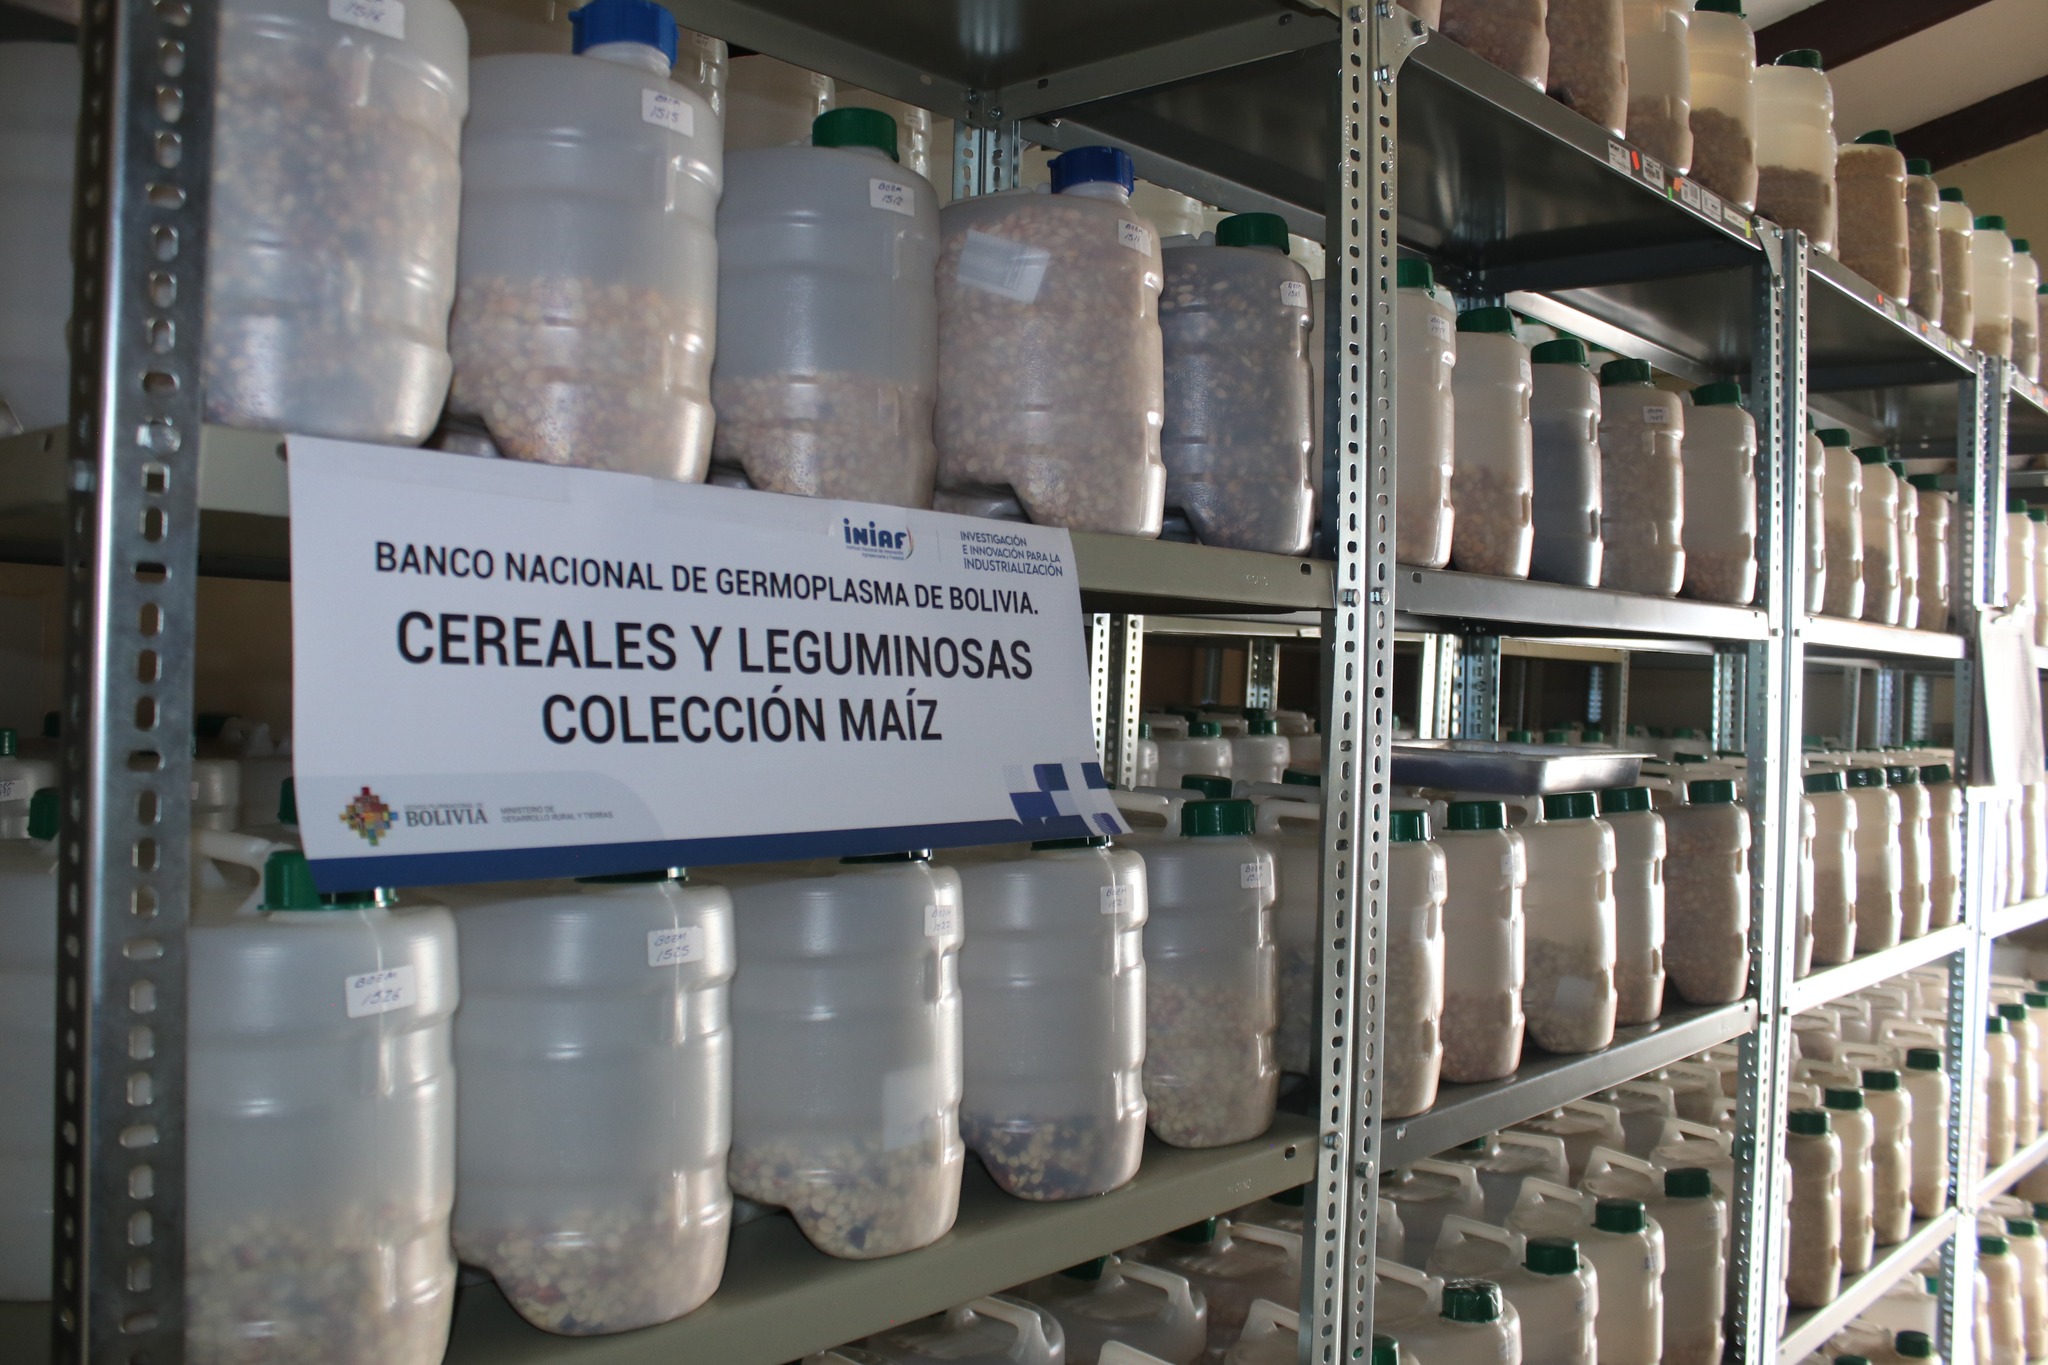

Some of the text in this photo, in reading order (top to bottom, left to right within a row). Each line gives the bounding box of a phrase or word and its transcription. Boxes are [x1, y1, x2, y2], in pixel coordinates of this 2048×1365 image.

[882, 194, 903, 206] 1512
[960, 531, 1027, 547] INVESTIGACIÓN
[962, 544, 1061, 563] E INNOVACIÓN PARA LA
[963, 558, 1063, 577] INDUSTRIALIZACIÓN
[375, 541, 1039, 615] BANCO NACIONAL DE GERMOPLASMA DE BOLIVIA.
[397, 611, 1033, 680] CEREALES Y LEGUMINOSAS
[542, 685, 942, 744] COLECCIÓN MAÍZ
[405, 808, 489, 827] BOLIVIA
[656, 945, 690, 962] 1525
[361, 987, 403, 1007] 1526
